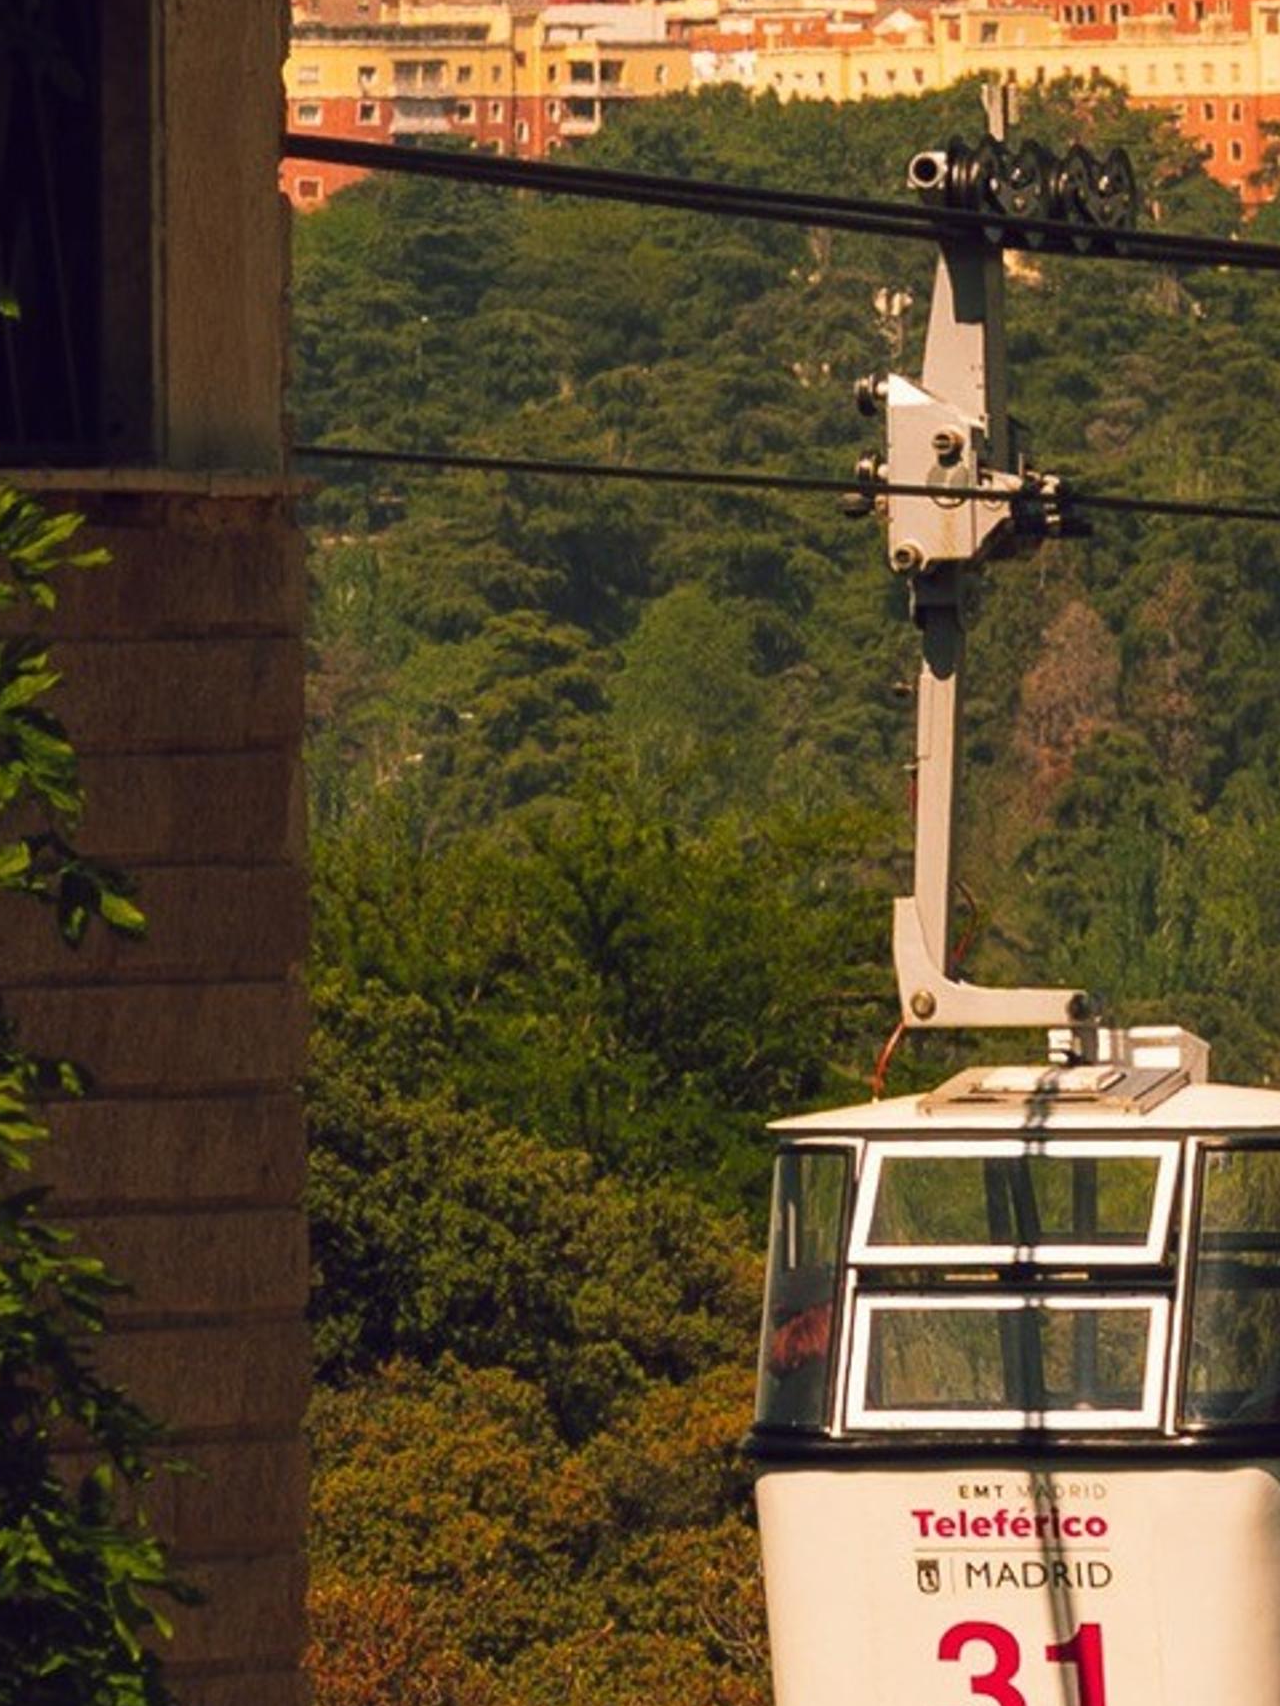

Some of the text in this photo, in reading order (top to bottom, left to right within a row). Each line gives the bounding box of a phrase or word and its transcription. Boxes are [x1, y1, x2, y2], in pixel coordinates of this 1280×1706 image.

[958, 1483, 1107, 1500] EMT MADRID
[911, 1506, 1108, 1538] Teleférico
[965, 1561, 1113, 1589] MADRID
